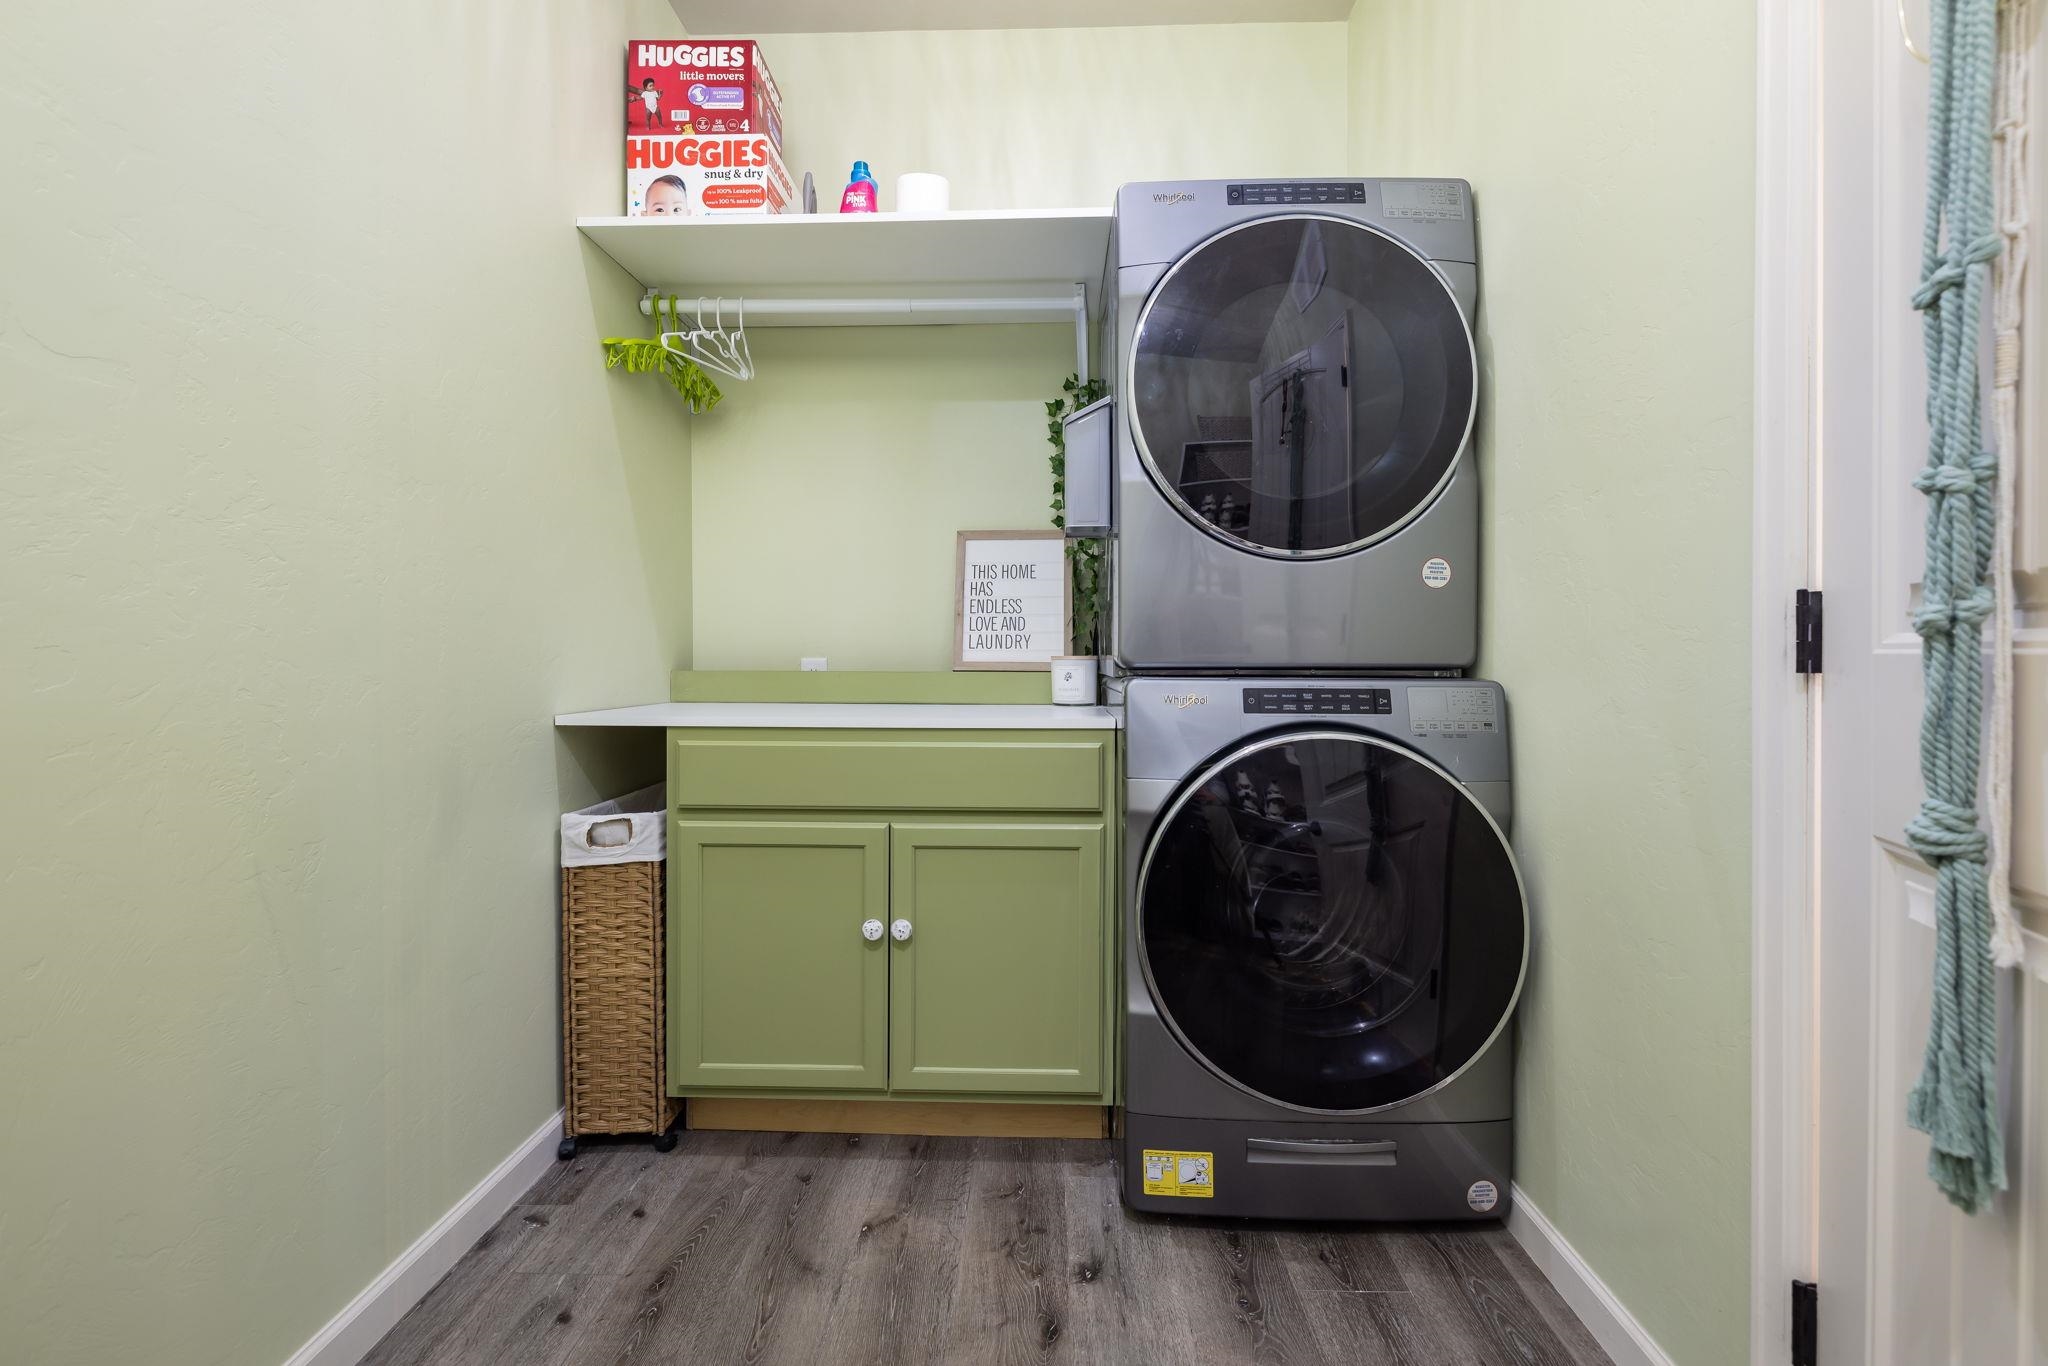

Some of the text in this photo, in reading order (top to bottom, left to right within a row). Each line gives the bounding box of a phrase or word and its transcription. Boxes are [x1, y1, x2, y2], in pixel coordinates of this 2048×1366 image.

[638, 44, 745, 68] HUGGIES
[679, 70, 745, 81] little movers
[739, 118, 750, 132] 4
[627, 138, 768, 170] HUGGIES
[704, 168, 764, 181] snug & dry
[733, 187, 762, 195] Leakproof
[1152, 192, 1195, 205] Whirlpool
[845, 195, 867, 205] PINK
[971, 564, 1037, 579] THIS HOME
[970, 581, 994, 596] HAS
[969, 598, 1023, 614] ENDLESS
[969, 616, 1026, 631] LOVE AND
[968, 634, 1031, 650] LAUNDRY
[1163, 693, 1208, 708] Whirlpool
